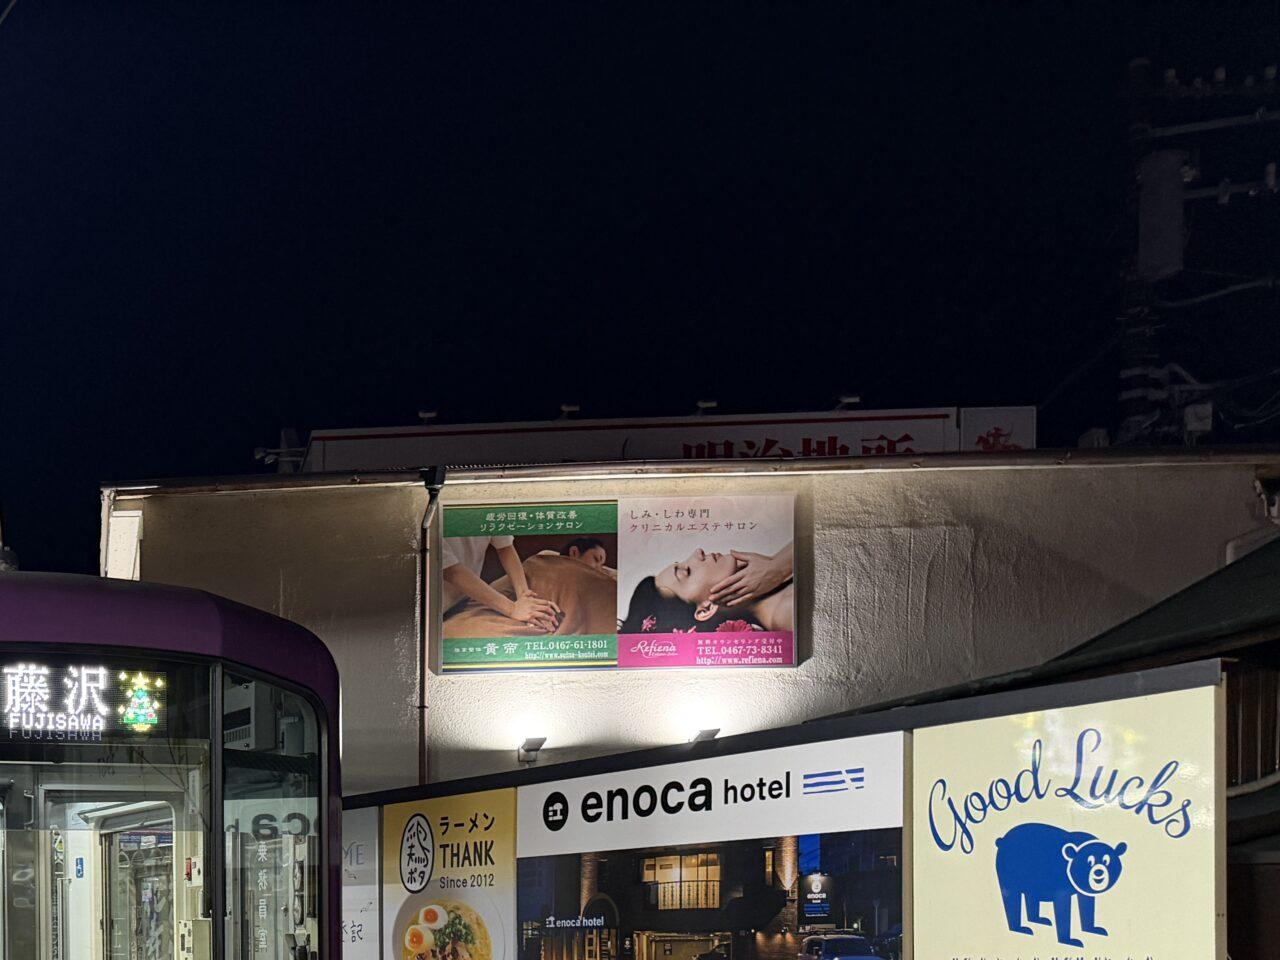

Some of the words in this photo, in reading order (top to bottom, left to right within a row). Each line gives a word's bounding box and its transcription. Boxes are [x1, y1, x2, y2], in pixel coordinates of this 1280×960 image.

[630, 508, 710, 519] しみ・しわ専門
[629, 521, 758, 533] クリニカルエステサロン
[3, 663, 109, 715] 藤沢
[8, 712, 106, 730] FUJISAWA
[581, 777, 713, 823] enoca
[724, 771, 791, 805] hotel
[928, 739, 1051, 854] Good
[1055, 728, 1191, 838] Lucks
[440, 813, 494, 835] ラーメン
[440, 840, 495, 868] THANK
[440, 876, 468, 888] Since
[470, 874, 494, 887] 2012
[556, 918, 581, 928] enoca
[582, 916, 604, 926] hotel
